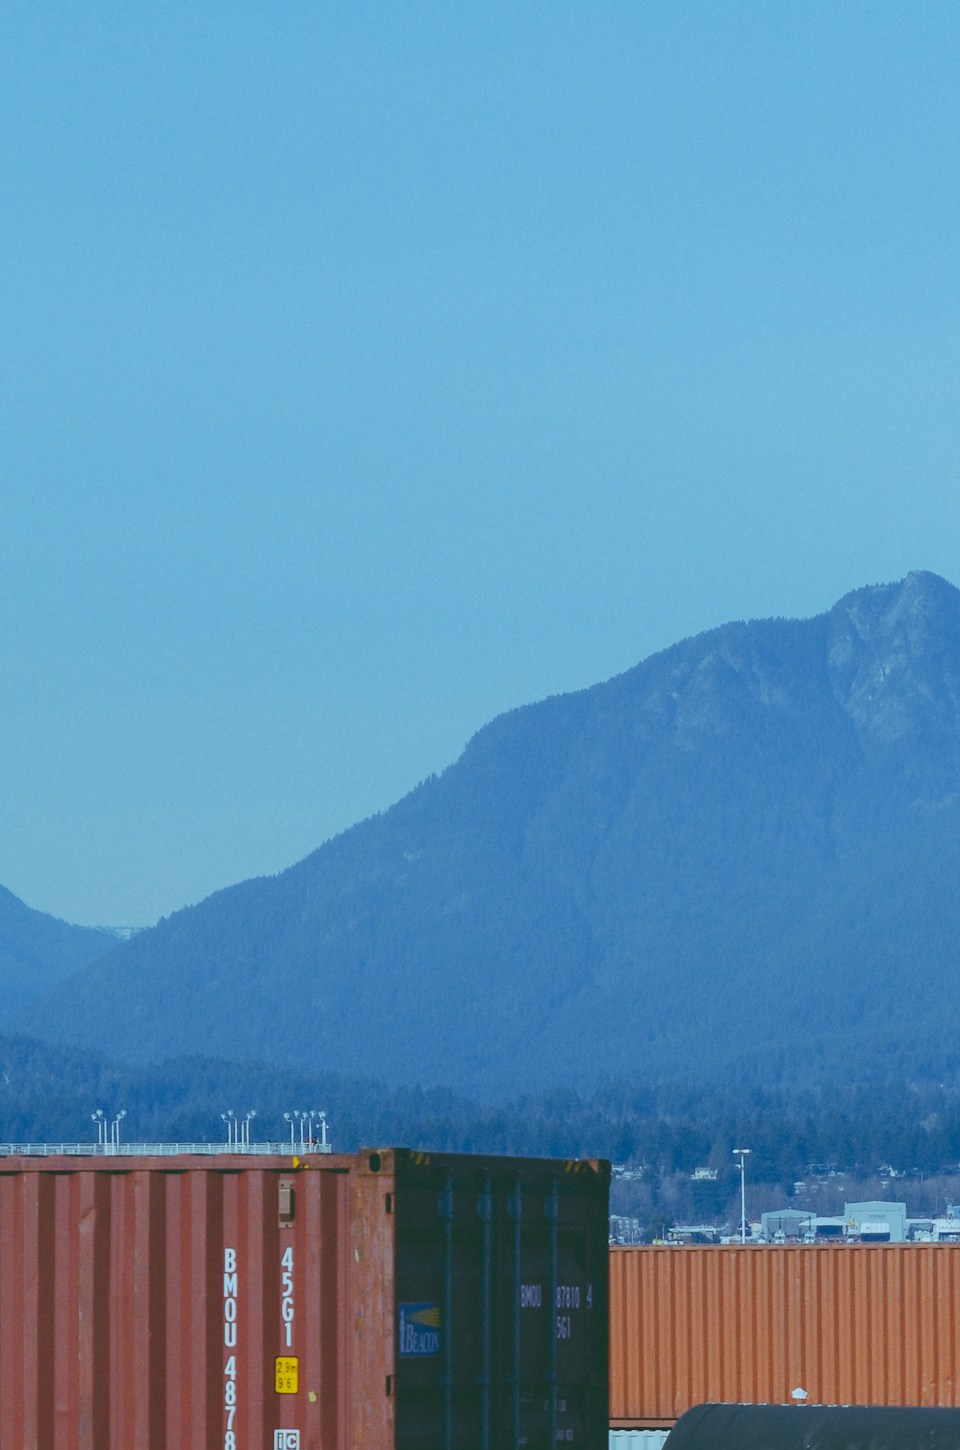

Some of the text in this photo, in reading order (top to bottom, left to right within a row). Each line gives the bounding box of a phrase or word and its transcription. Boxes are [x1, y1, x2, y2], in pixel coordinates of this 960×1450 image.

[223, 1248, 238, 1347] BMOU
[280, 1247, 294, 1347] 45G1
[520, 1284, 542, 1307] BMOU
[556, 1286, 580, 1308] 87810
[406, 1323, 440, 1353] BEACON
[556, 1316, 571, 1338] 5G1
